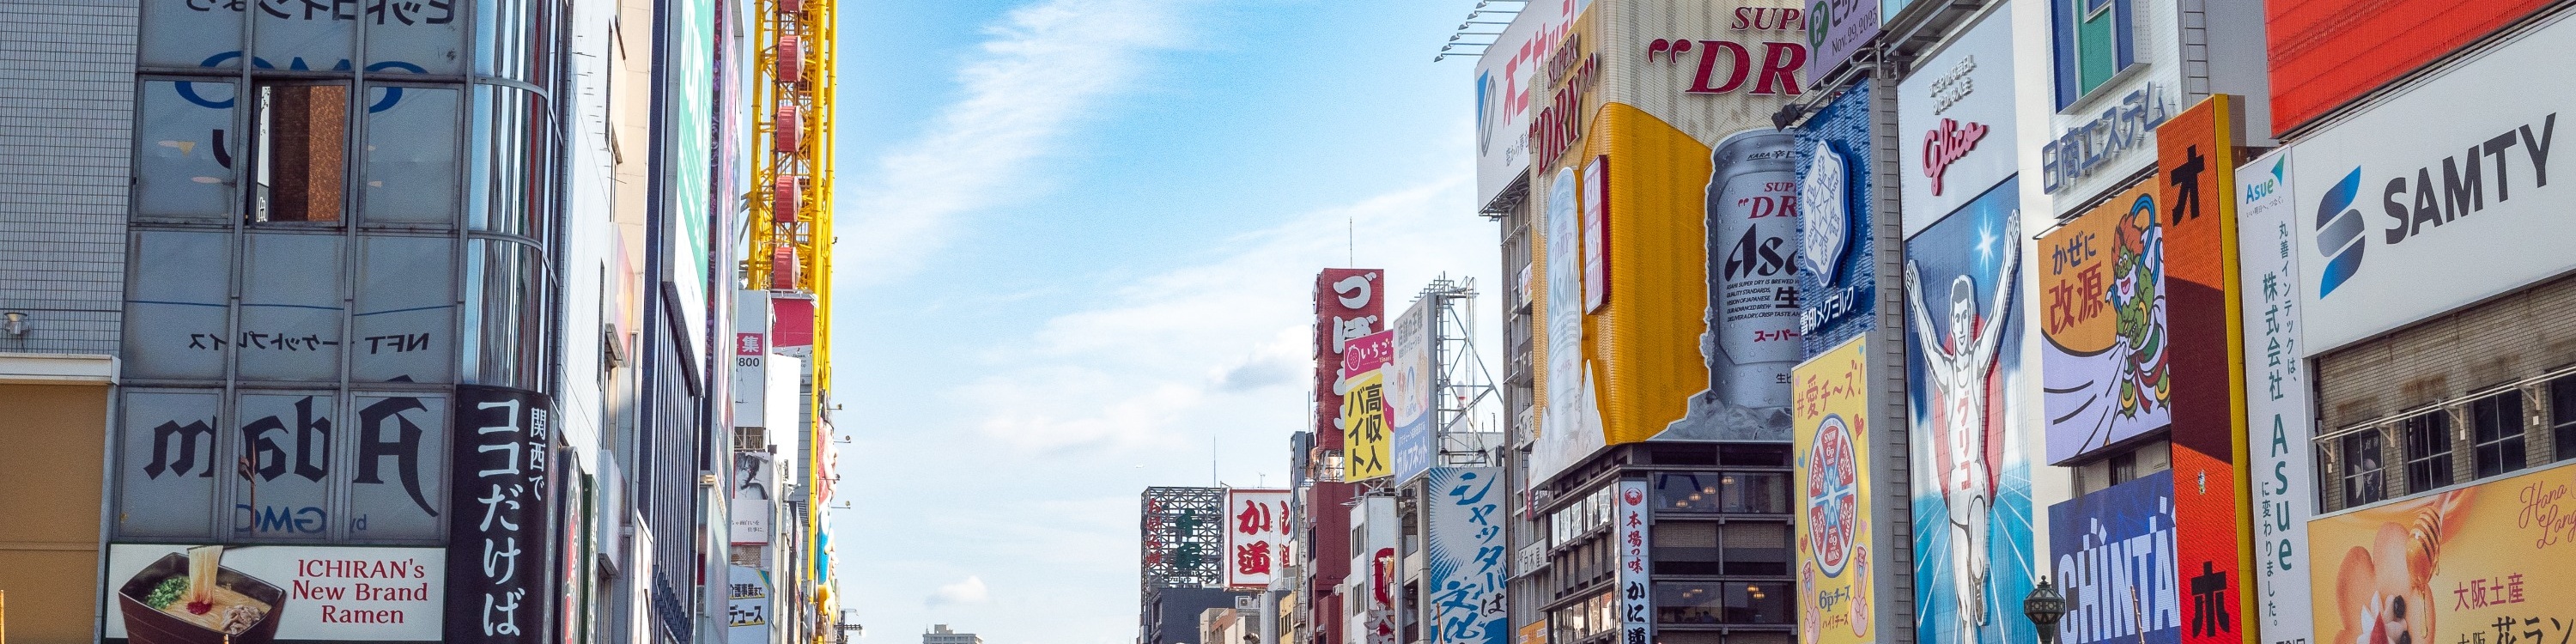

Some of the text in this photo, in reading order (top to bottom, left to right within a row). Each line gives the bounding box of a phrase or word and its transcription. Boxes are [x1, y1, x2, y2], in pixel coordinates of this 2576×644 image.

[1547, 33, 1578, 92] SUPER
[1832, 34, 1847, 57] Nov.
[1858, 6, 1877, 34] 2023
[1923, 118, 1989, 197] Glico
[2042, 81, 2166, 196] 日商エステム
[2246, 178, 2274, 205] Asue
[2384, 112, 2557, 245] SAMTY
[2052, 230, 2096, 276] かぜに
[1800, 286, 1854, 336] 雪印メグミルク
[2049, 260, 2104, 336] 改源
[2279, 221, 2297, 382] 丸善インテックは、
[528, 407, 547, 501] 関西で
[1348, 386, 1364, 477] バイト
[1365, 383, 1382, 474] 高収入
[1958, 389, 1971, 491] グリコ
[2263, 271, 2293, 571] 株式会社 Asue
[2518, 480, 2567, 529] Hana
[298, 558, 425, 579] ICHIRAN's
[1625, 510, 1643, 574] 本場の味
[2261, 481, 2278, 627] に変わりました。
[292, 580, 428, 601] New Brand
[321, 605, 404, 623] Ramen
[2453, 572, 2525, 612] 大阪土産
